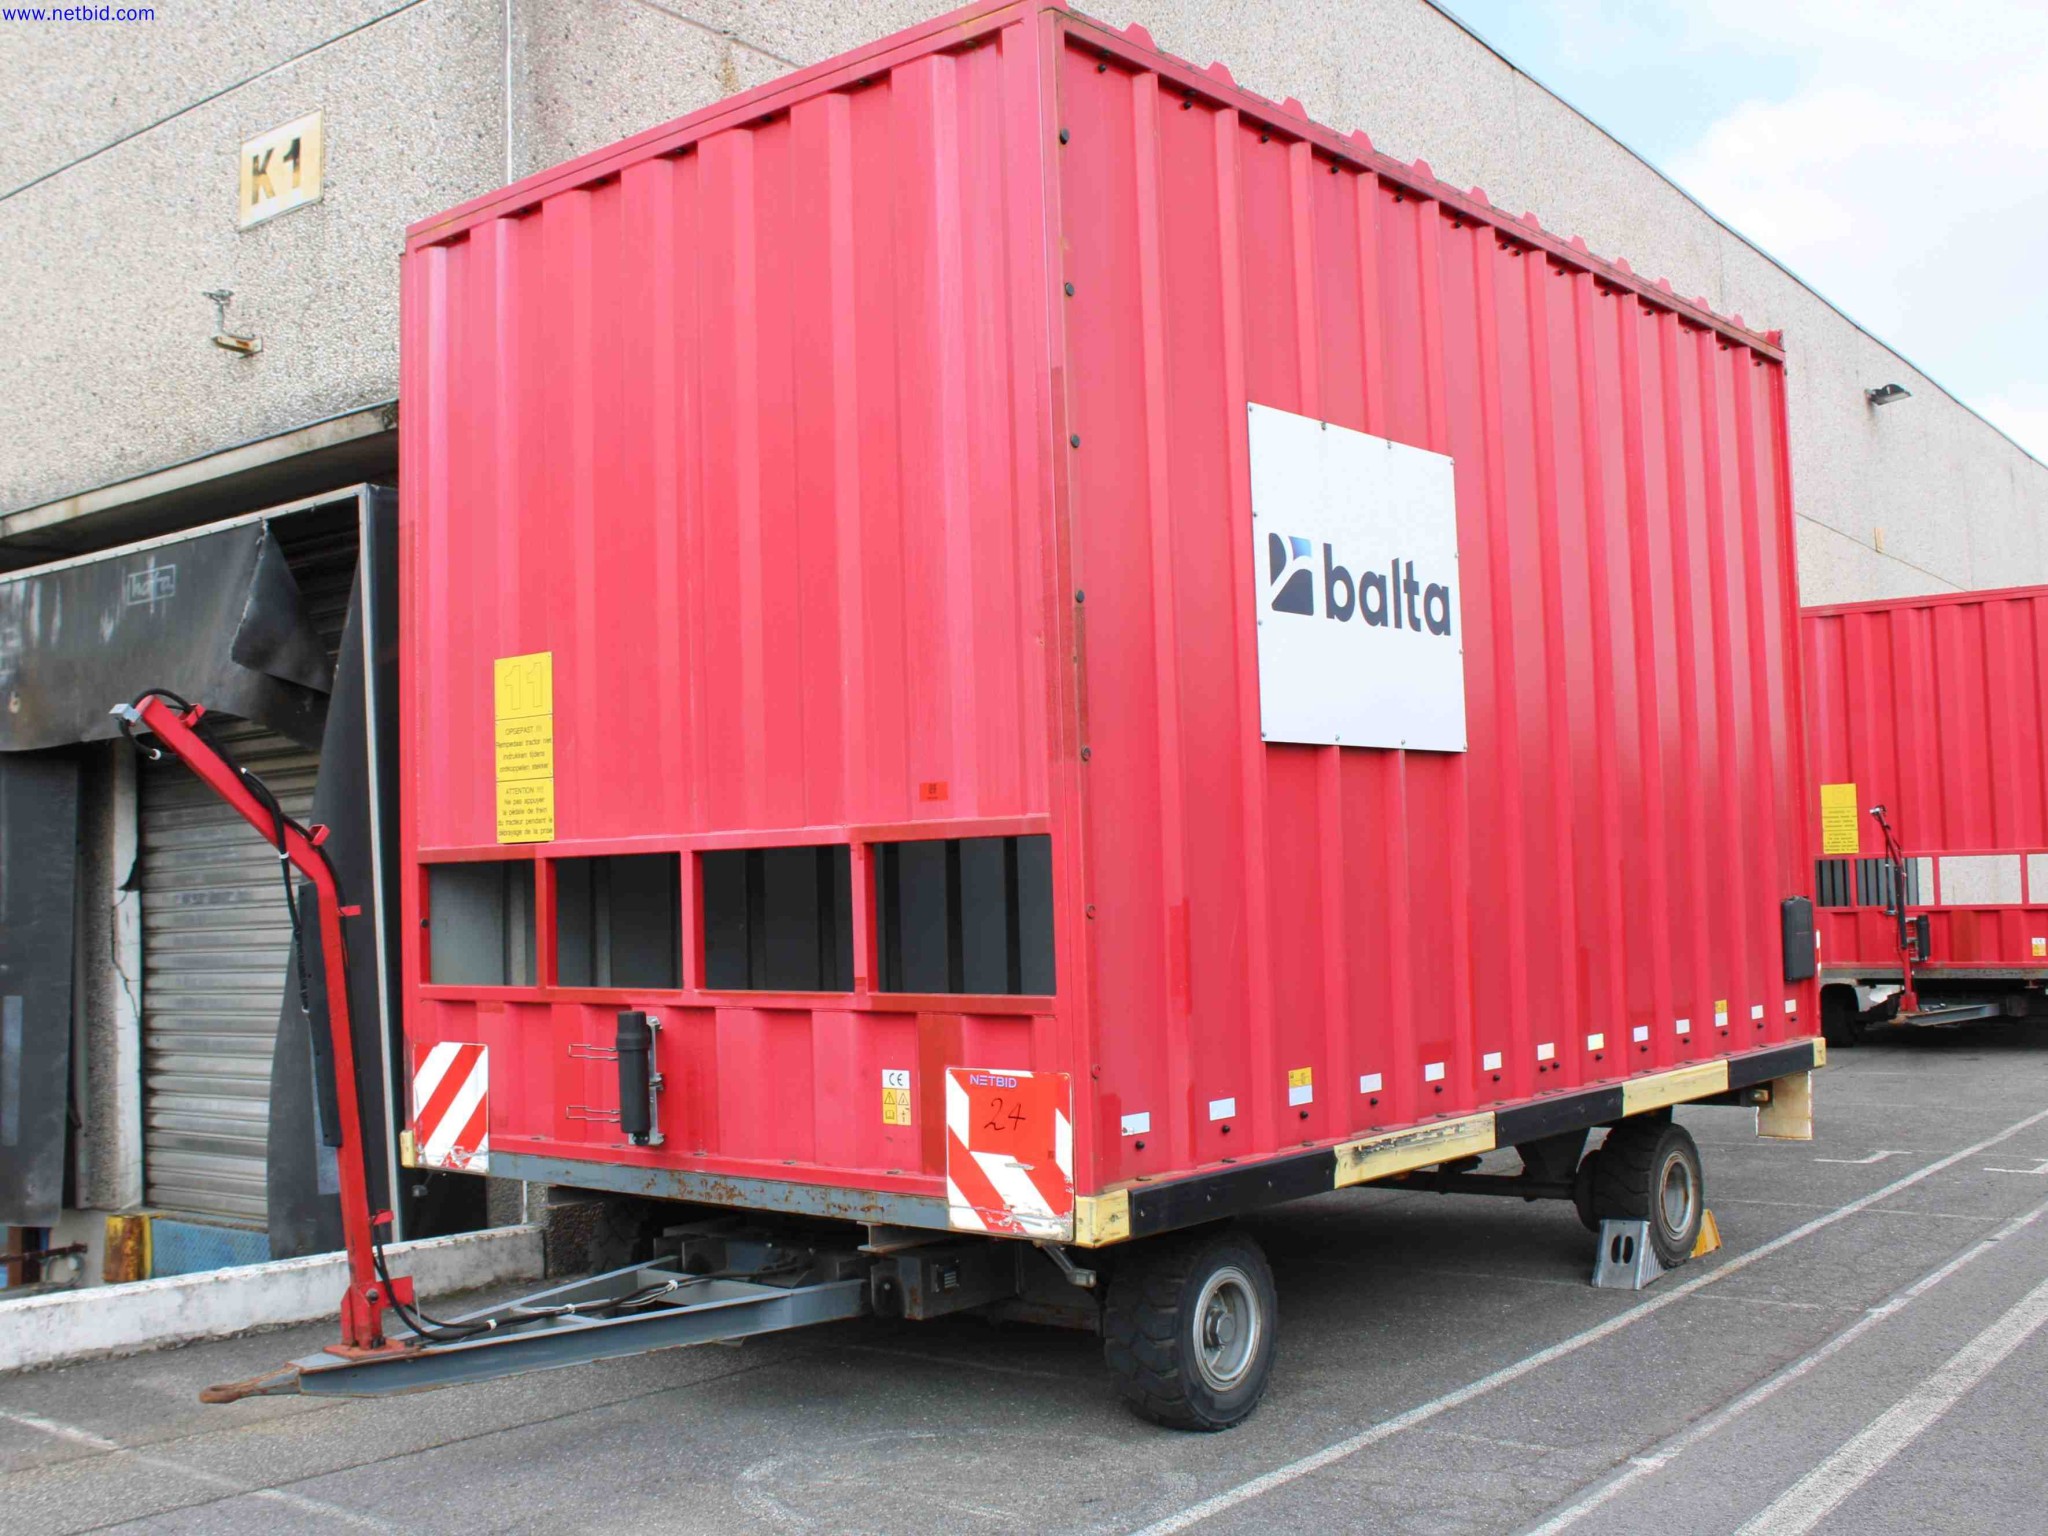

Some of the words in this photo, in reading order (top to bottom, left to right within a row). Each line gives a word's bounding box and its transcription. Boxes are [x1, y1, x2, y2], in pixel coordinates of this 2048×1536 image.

[252, 137, 302, 206] K1
[1323, 542, 1452, 637] balta
[504, 662, 543, 710] 11
[889, 1072, 903, 1086] CE
[970, 1074, 1017, 1088] NETBID
[984, 1098, 1026, 1131] 24
